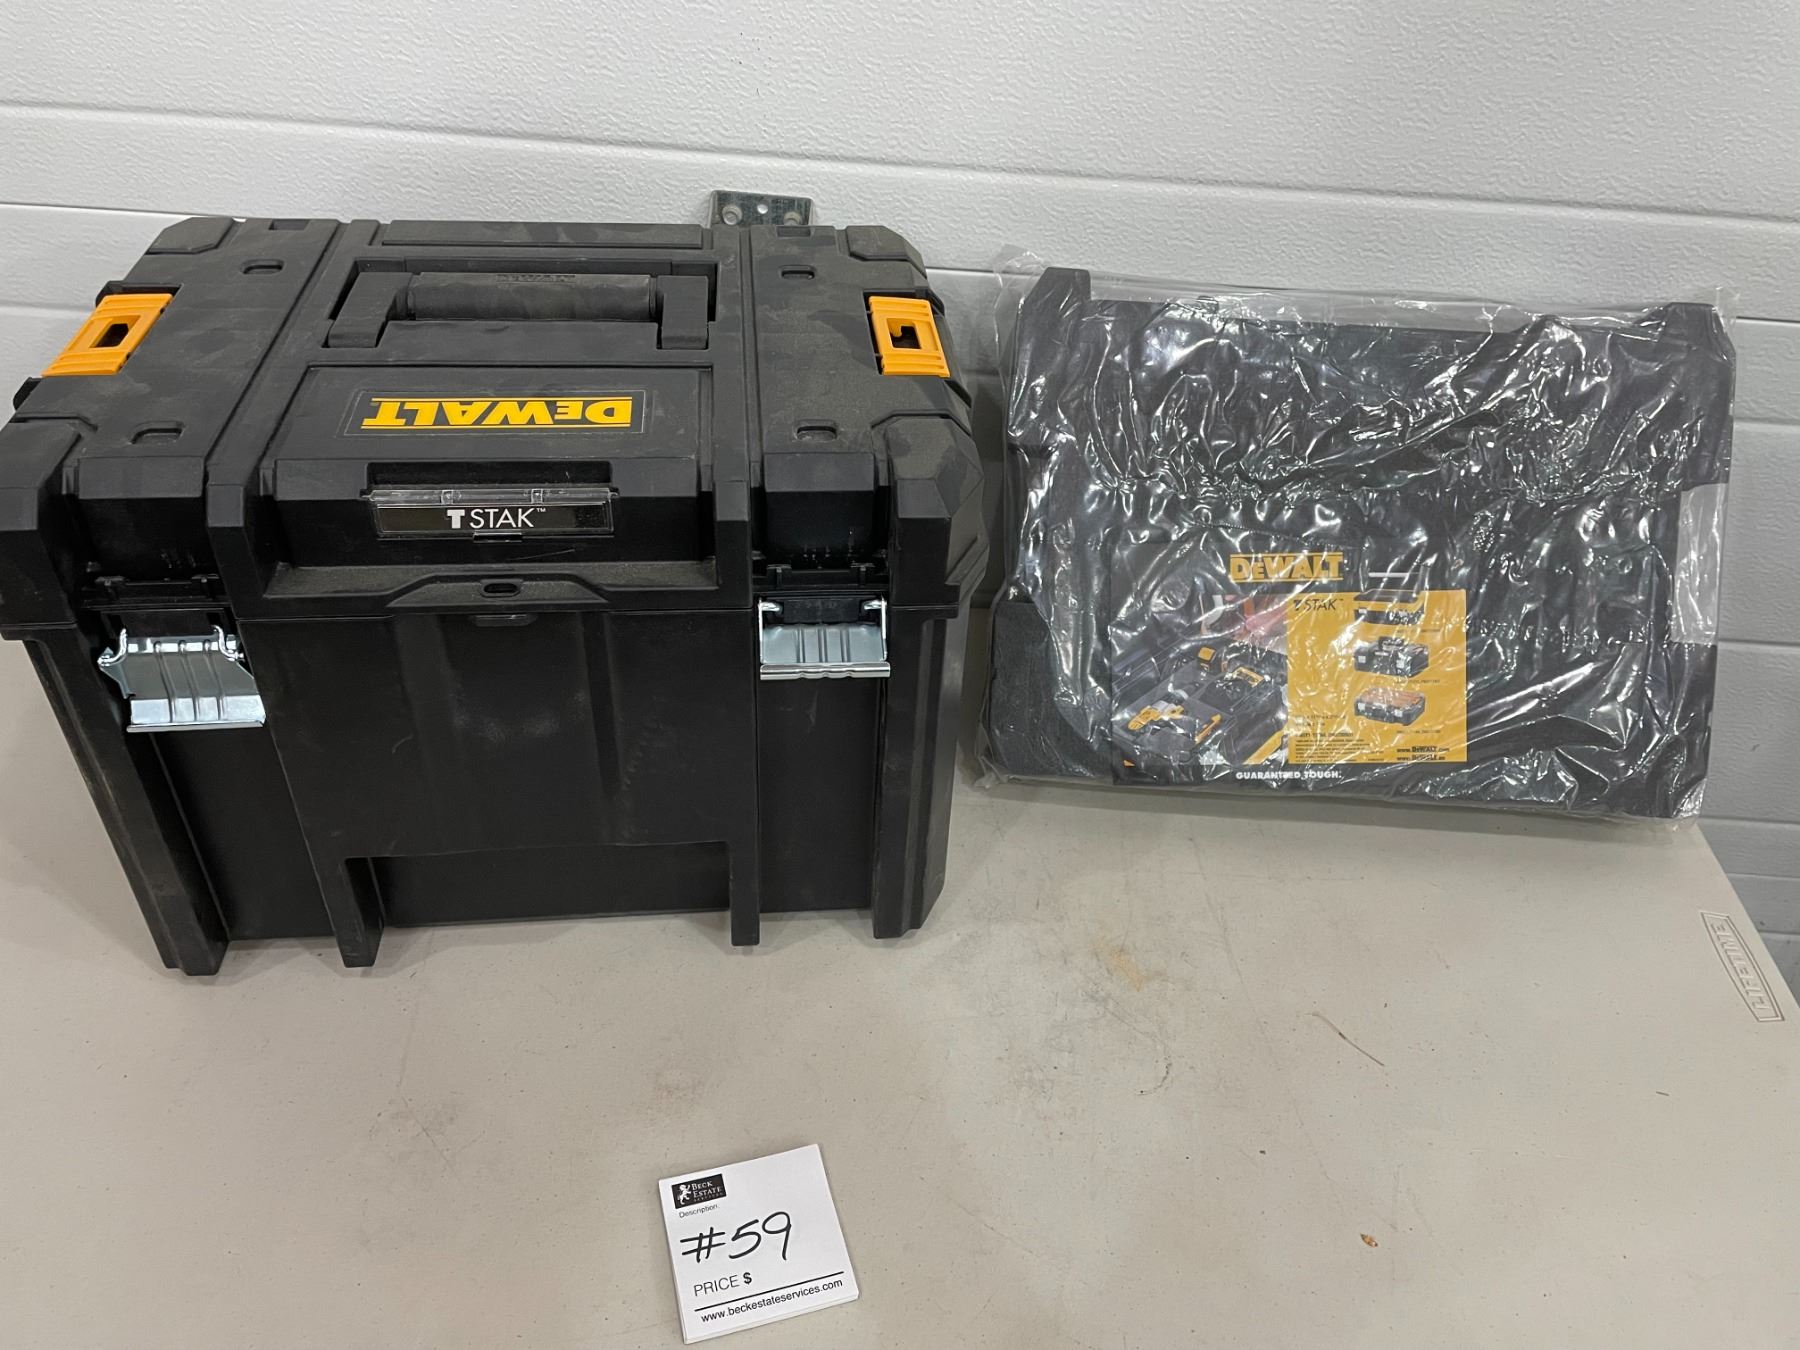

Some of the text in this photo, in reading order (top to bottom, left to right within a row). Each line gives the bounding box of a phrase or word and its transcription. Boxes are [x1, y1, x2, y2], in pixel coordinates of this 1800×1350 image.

[680, 1211, 792, 1263] #59
[694, 1272, 753, 1297] PRICE $
[701, 1278, 843, 1323] www.beckestateservices.com
